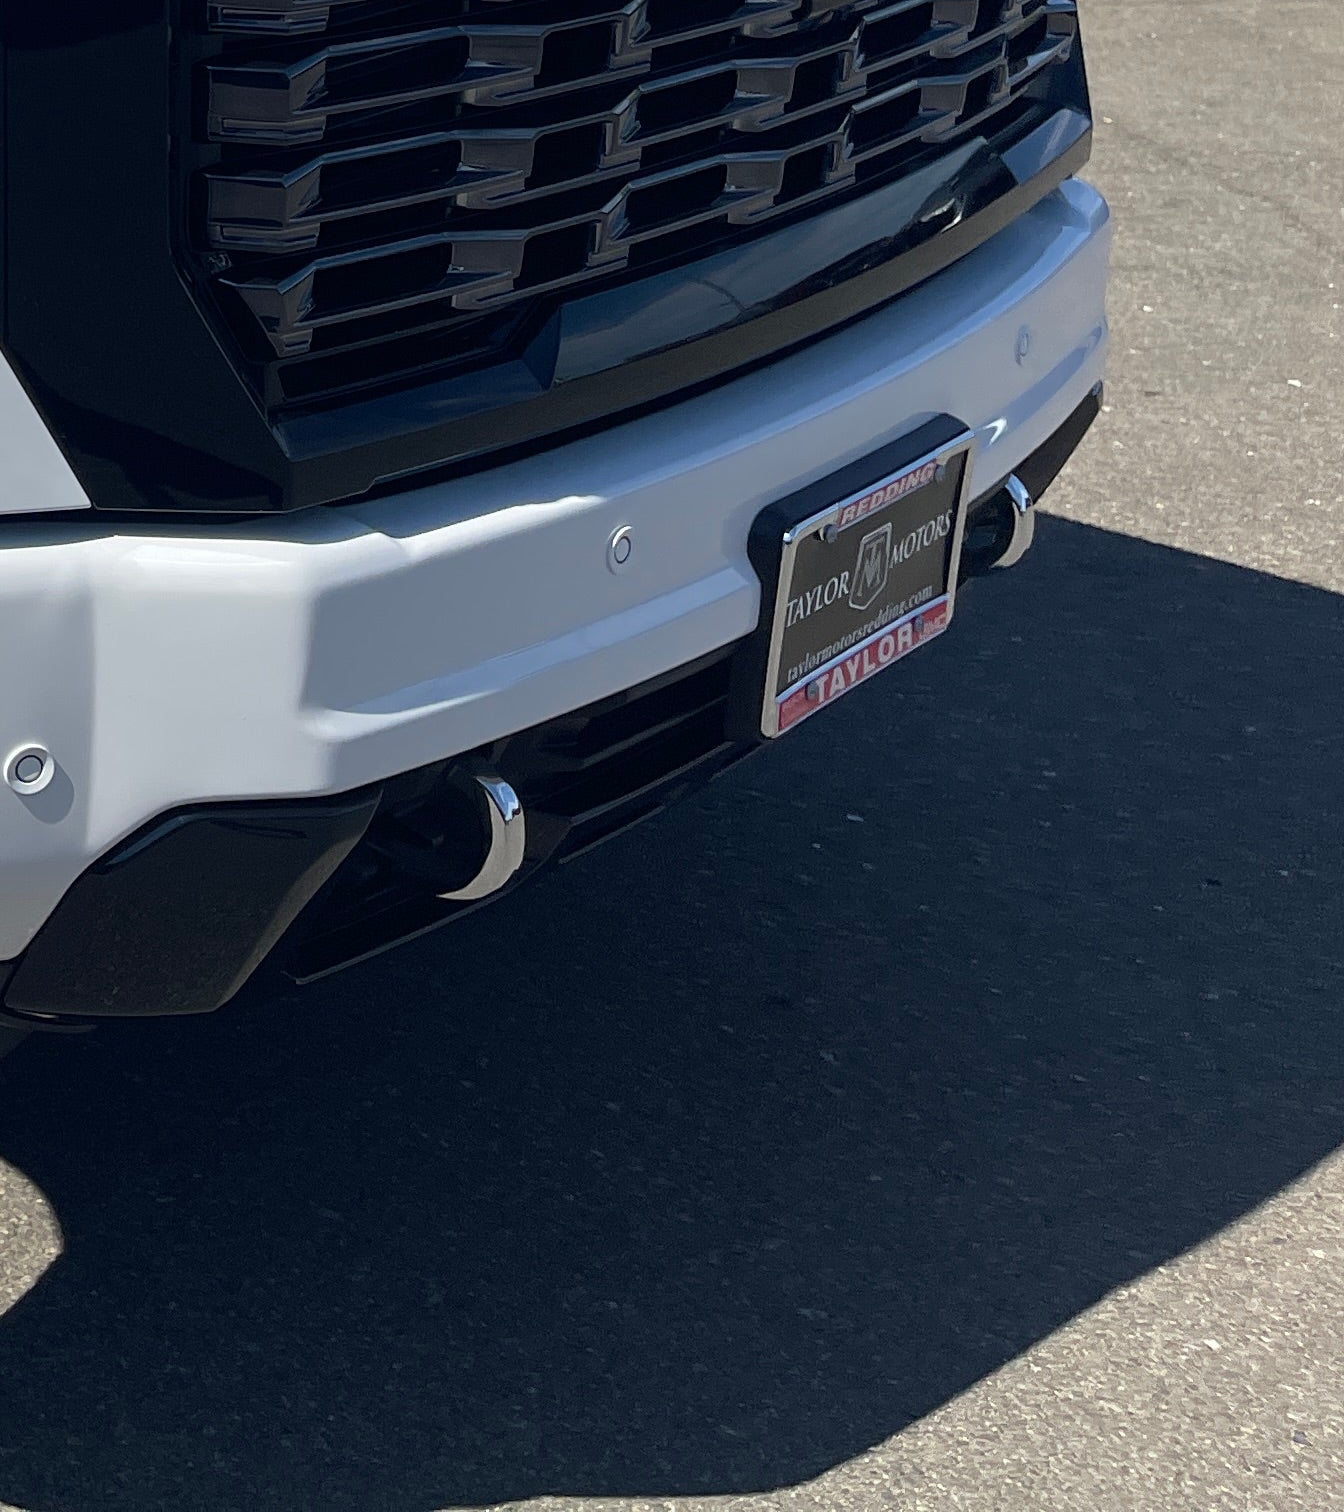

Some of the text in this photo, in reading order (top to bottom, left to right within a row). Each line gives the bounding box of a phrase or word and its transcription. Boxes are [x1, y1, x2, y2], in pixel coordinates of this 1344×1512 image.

[838, 461, 937, 527] REDDING
[785, 570, 850, 627] TAYLOR
[889, 509, 953, 569] MOTORS
[814, 622, 913, 703] TAYLOR
